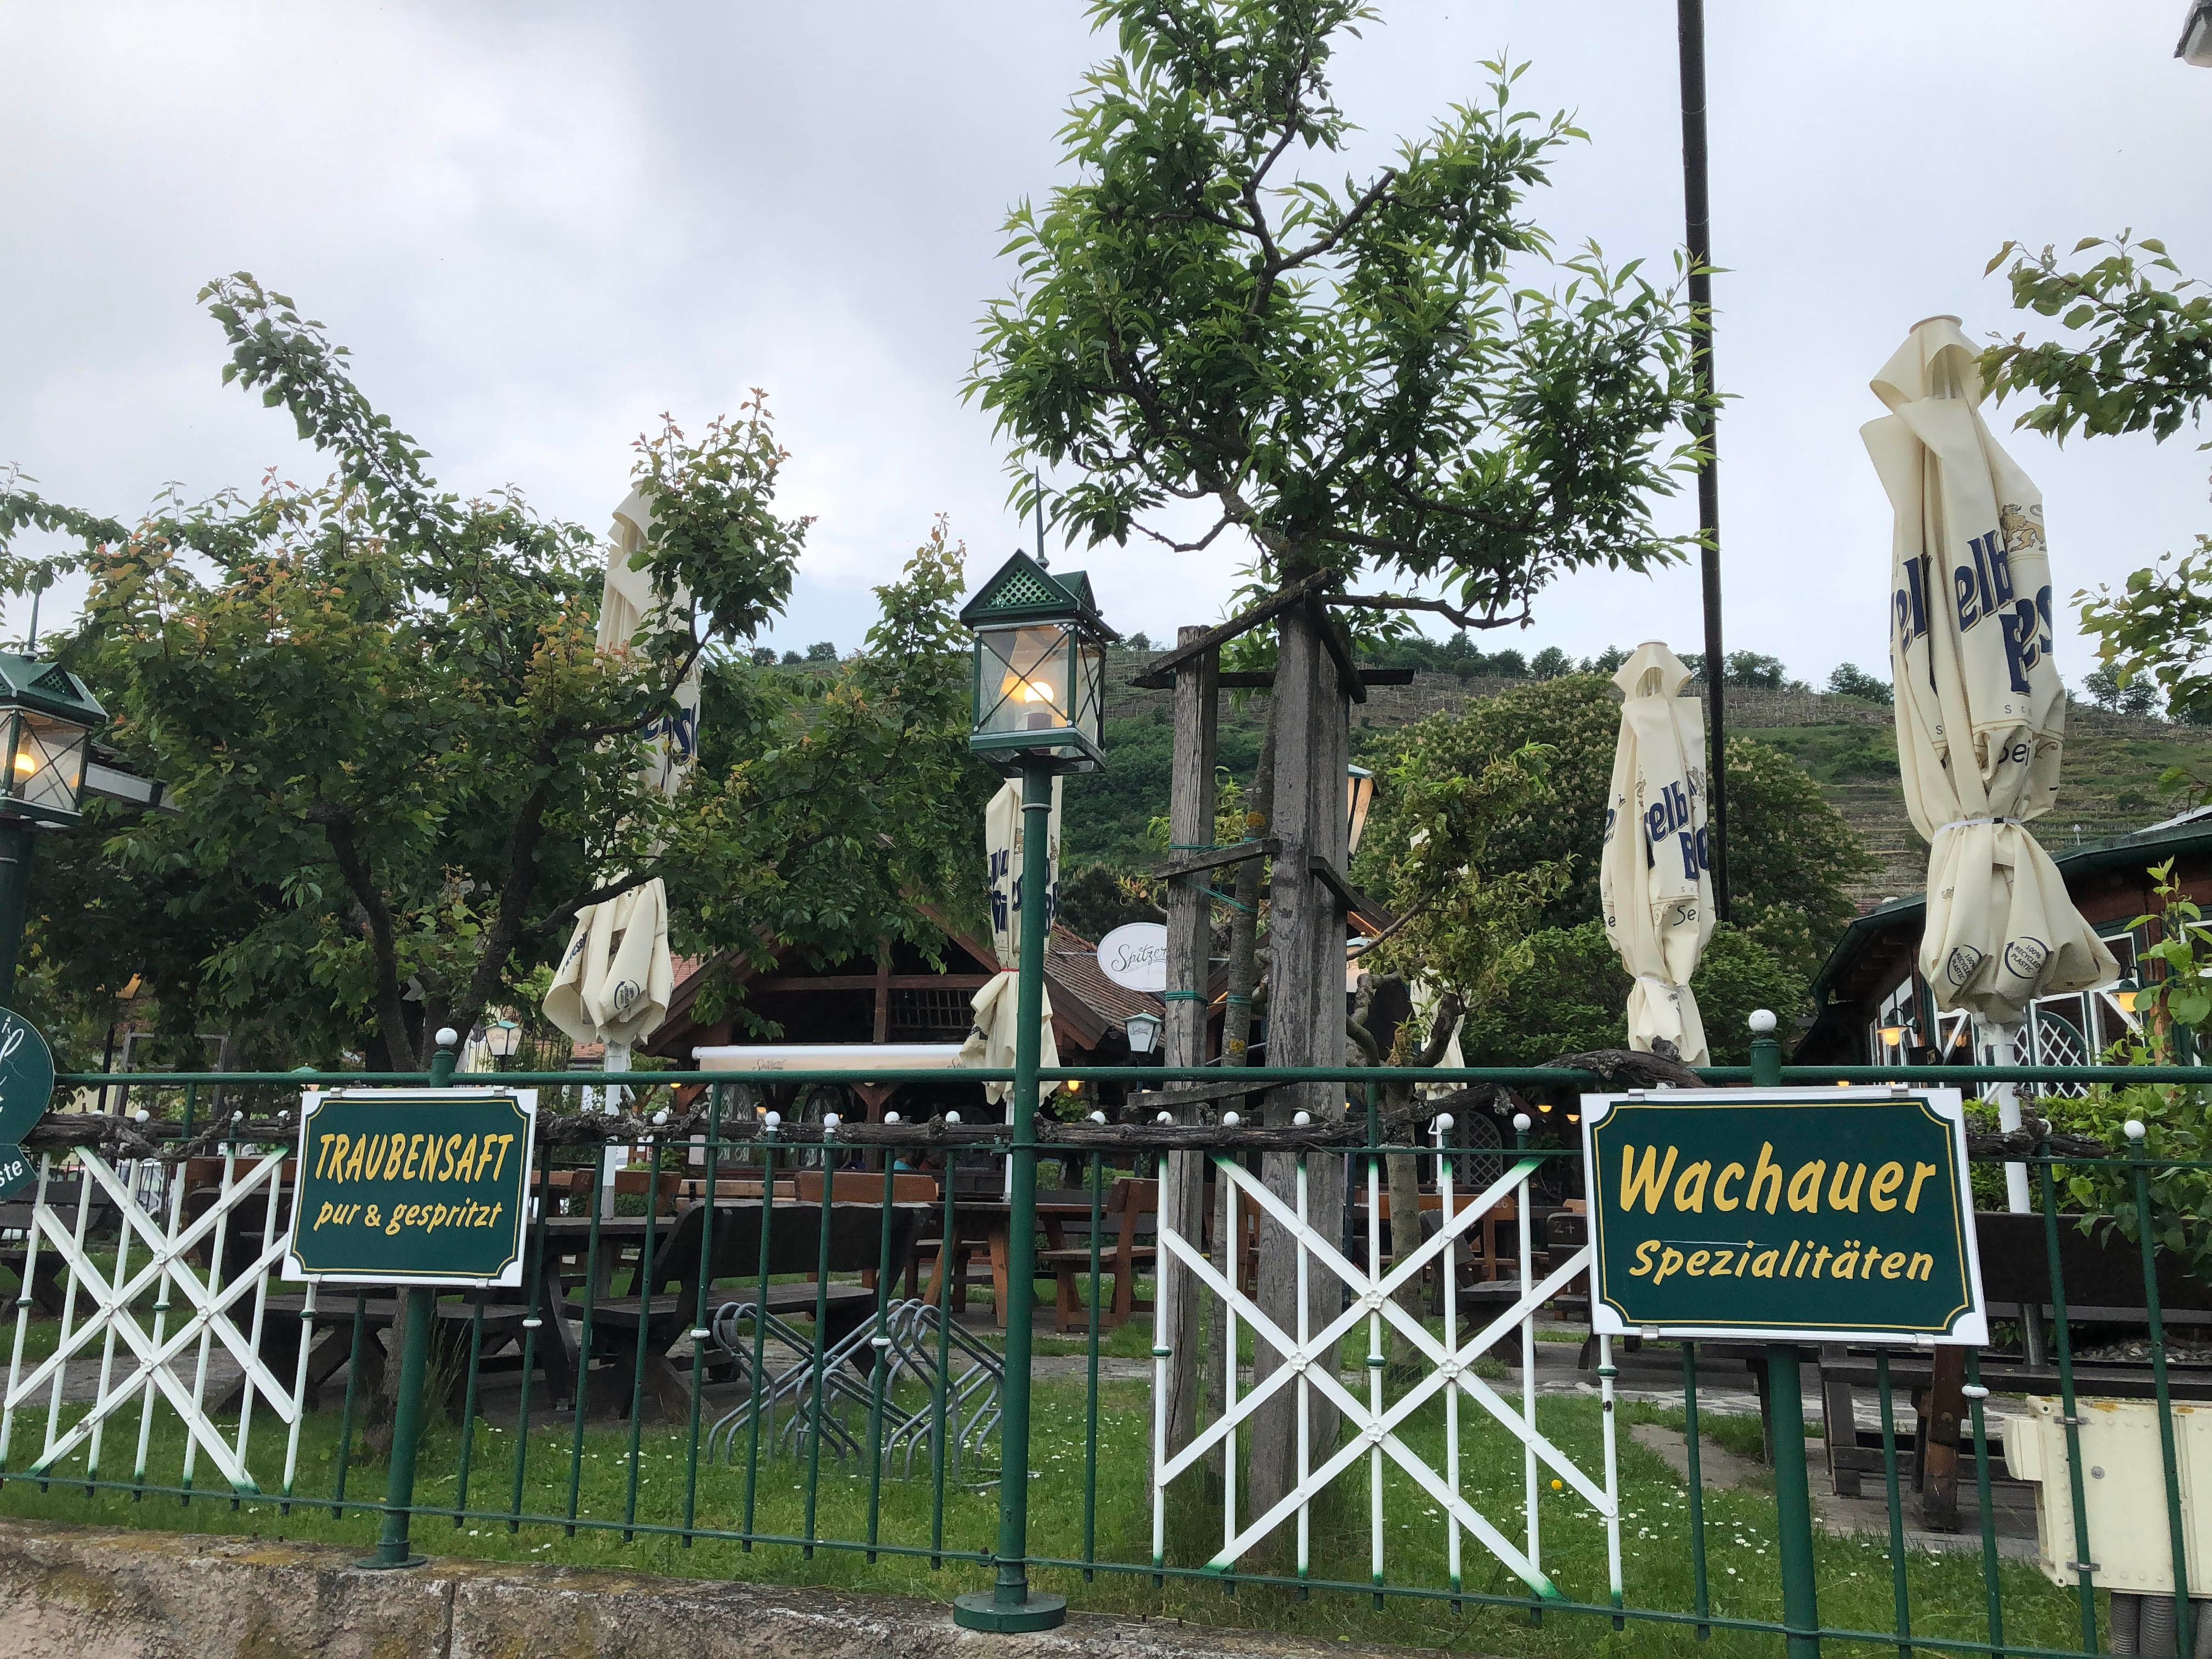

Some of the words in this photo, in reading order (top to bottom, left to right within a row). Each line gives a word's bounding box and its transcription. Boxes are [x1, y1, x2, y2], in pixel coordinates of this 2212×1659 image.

[2011, 953, 2033, 973] PLASTIC
[2014, 946, 2041, 969] RECYCLED
[2025, 945, 2042, 959] 100%
[315, 1132, 514, 1184] TRAUBENSAFT
[1620, 1141, 1937, 1215] Wachauer
[313, 1201, 361, 1232] pur
[364, 1205, 381, 1228] &
[385, 1197, 502, 1235] gespritzt
[1629, 1239, 1934, 1286] Spezialitäten
